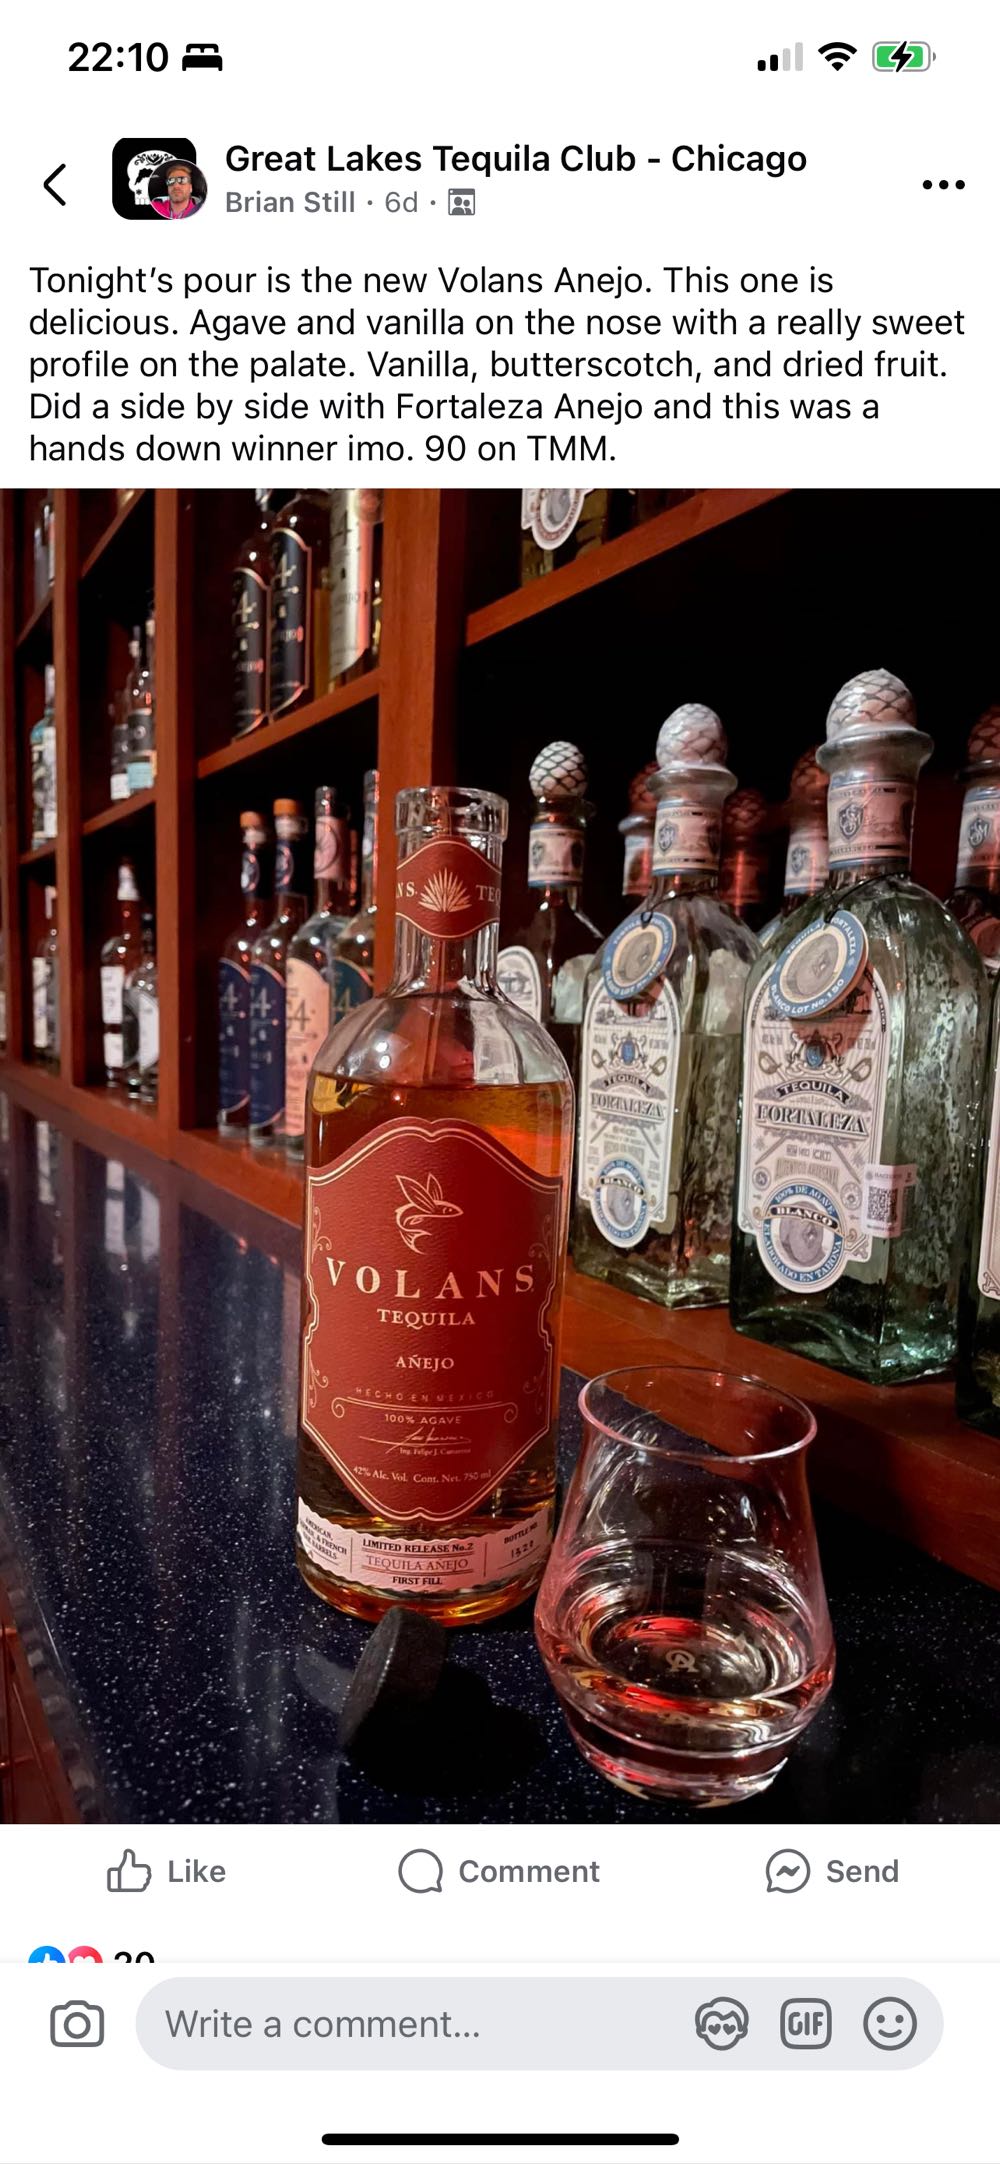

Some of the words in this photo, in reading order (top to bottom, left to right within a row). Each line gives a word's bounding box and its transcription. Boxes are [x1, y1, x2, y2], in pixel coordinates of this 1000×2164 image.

[791, 1004, 810, 1014] LOT
[780, 1080, 845, 1101] TEQUILA
[755, 1103, 867, 1134] FORTALEZA
[795, 1185, 808, 1195] DE
[809, 1189, 835, 1215] AGAVE
[776, 1206, 834, 1227] BLANCO
[799, 1273, 814, 1282] EN
[814, 1240, 842, 1278] TAHONA
[326, 1257, 535, 1299] VOLANS
[377, 1308, 476, 1330] TEQUILA
[396, 1354, 454, 1372] AÑEJO
[356, 1387, 403, 1400] HECHO
[384, 1413, 415, 1424] 100%
[421, 1415, 462, 1425] AGAVE
[353, 1465, 371, 1477] 42%
[372, 1470, 390, 1480] Alc.
[391, 1472, 408, 1482] Vol.
[413, 1473, 439, 1483] Cont.
[480, 1469, 491, 1479] ml
[362, 1538, 402, 1552] LIMITED
[404, 1542, 450, 1553] RELEASE
[366, 1554, 423, 1571] TEQUILA
[392, 1576, 420, 1585] FIRST
[422, 1577, 443, 1585] FILL
